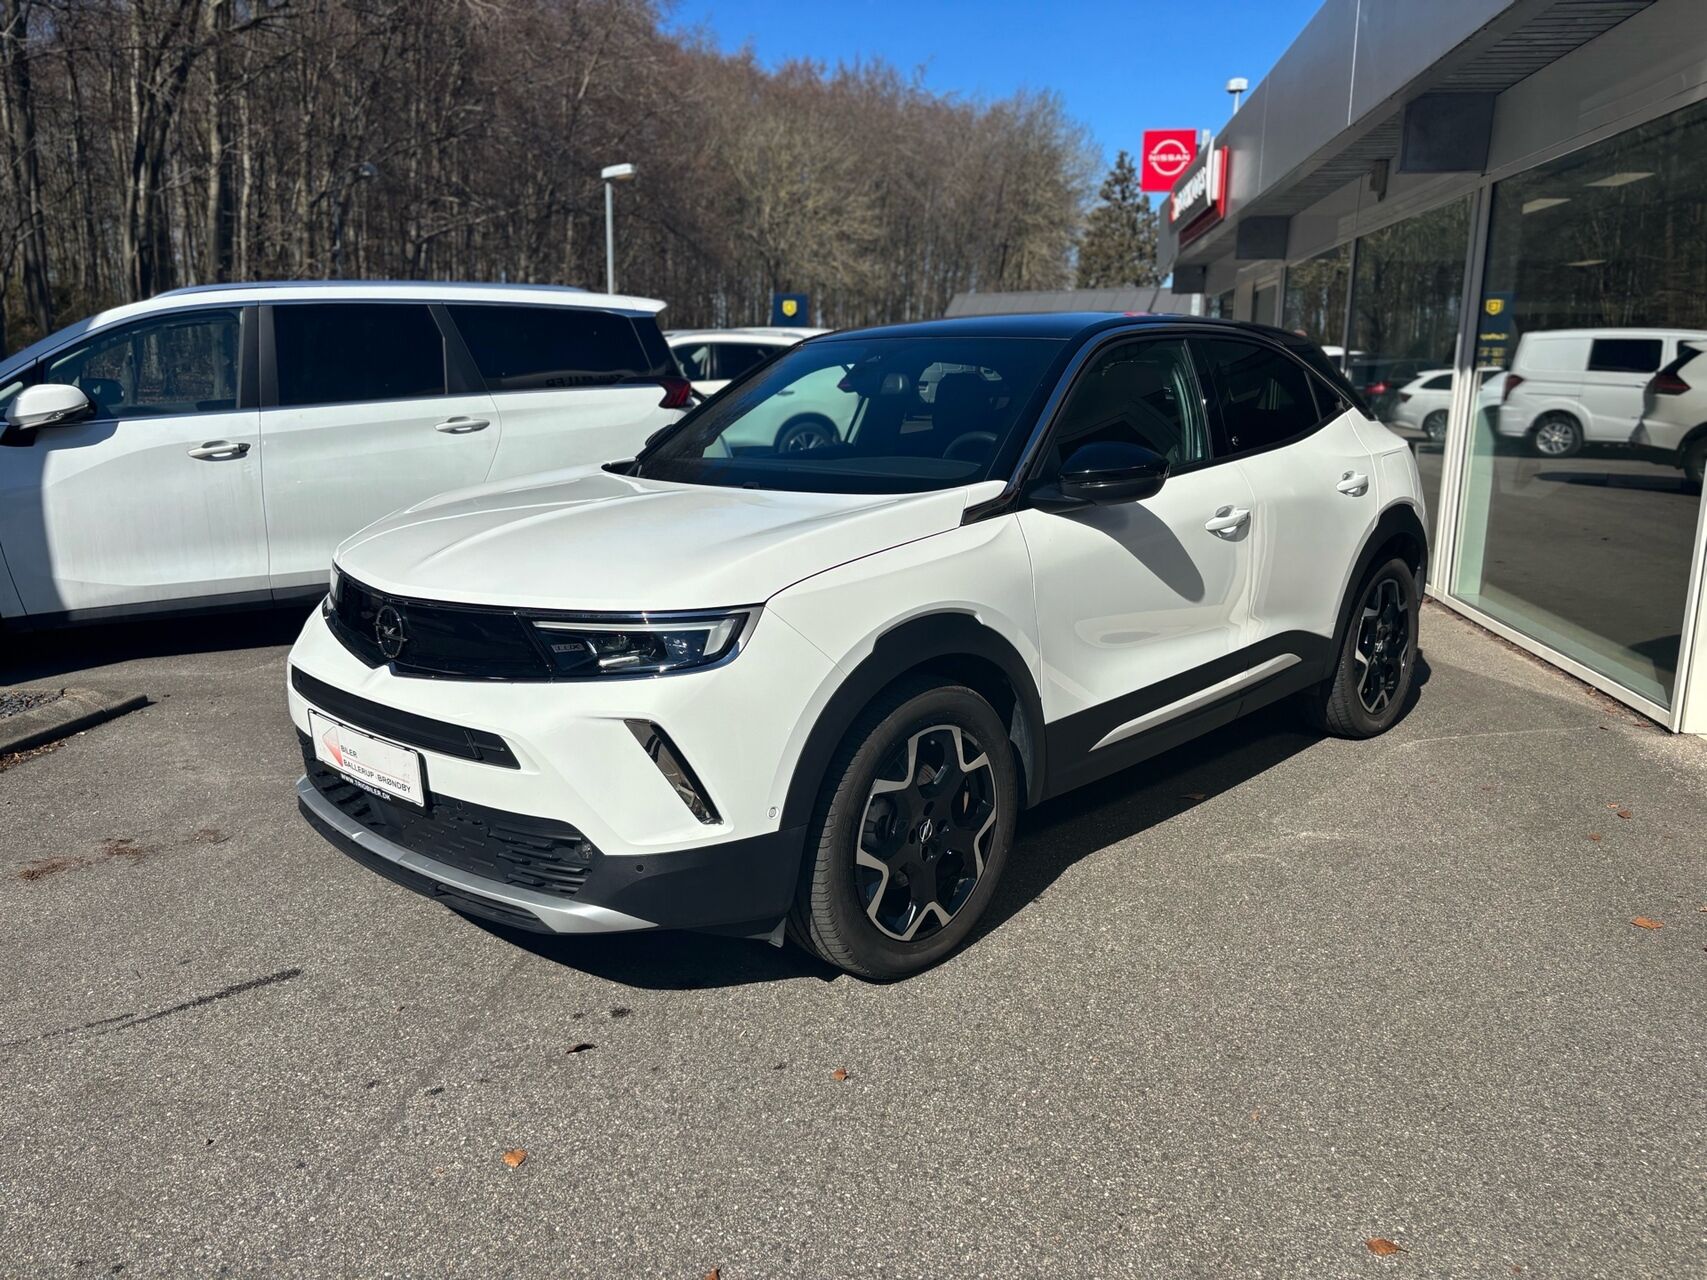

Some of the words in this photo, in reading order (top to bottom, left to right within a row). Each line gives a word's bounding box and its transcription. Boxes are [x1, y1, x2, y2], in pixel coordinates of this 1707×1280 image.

[1148, 153, 1191, 162] NISSAN
[340, 744, 357, 758] BILER
[343, 759, 375, 780] BALLERUP
[377, 773, 412, 793] BRØNDBY
